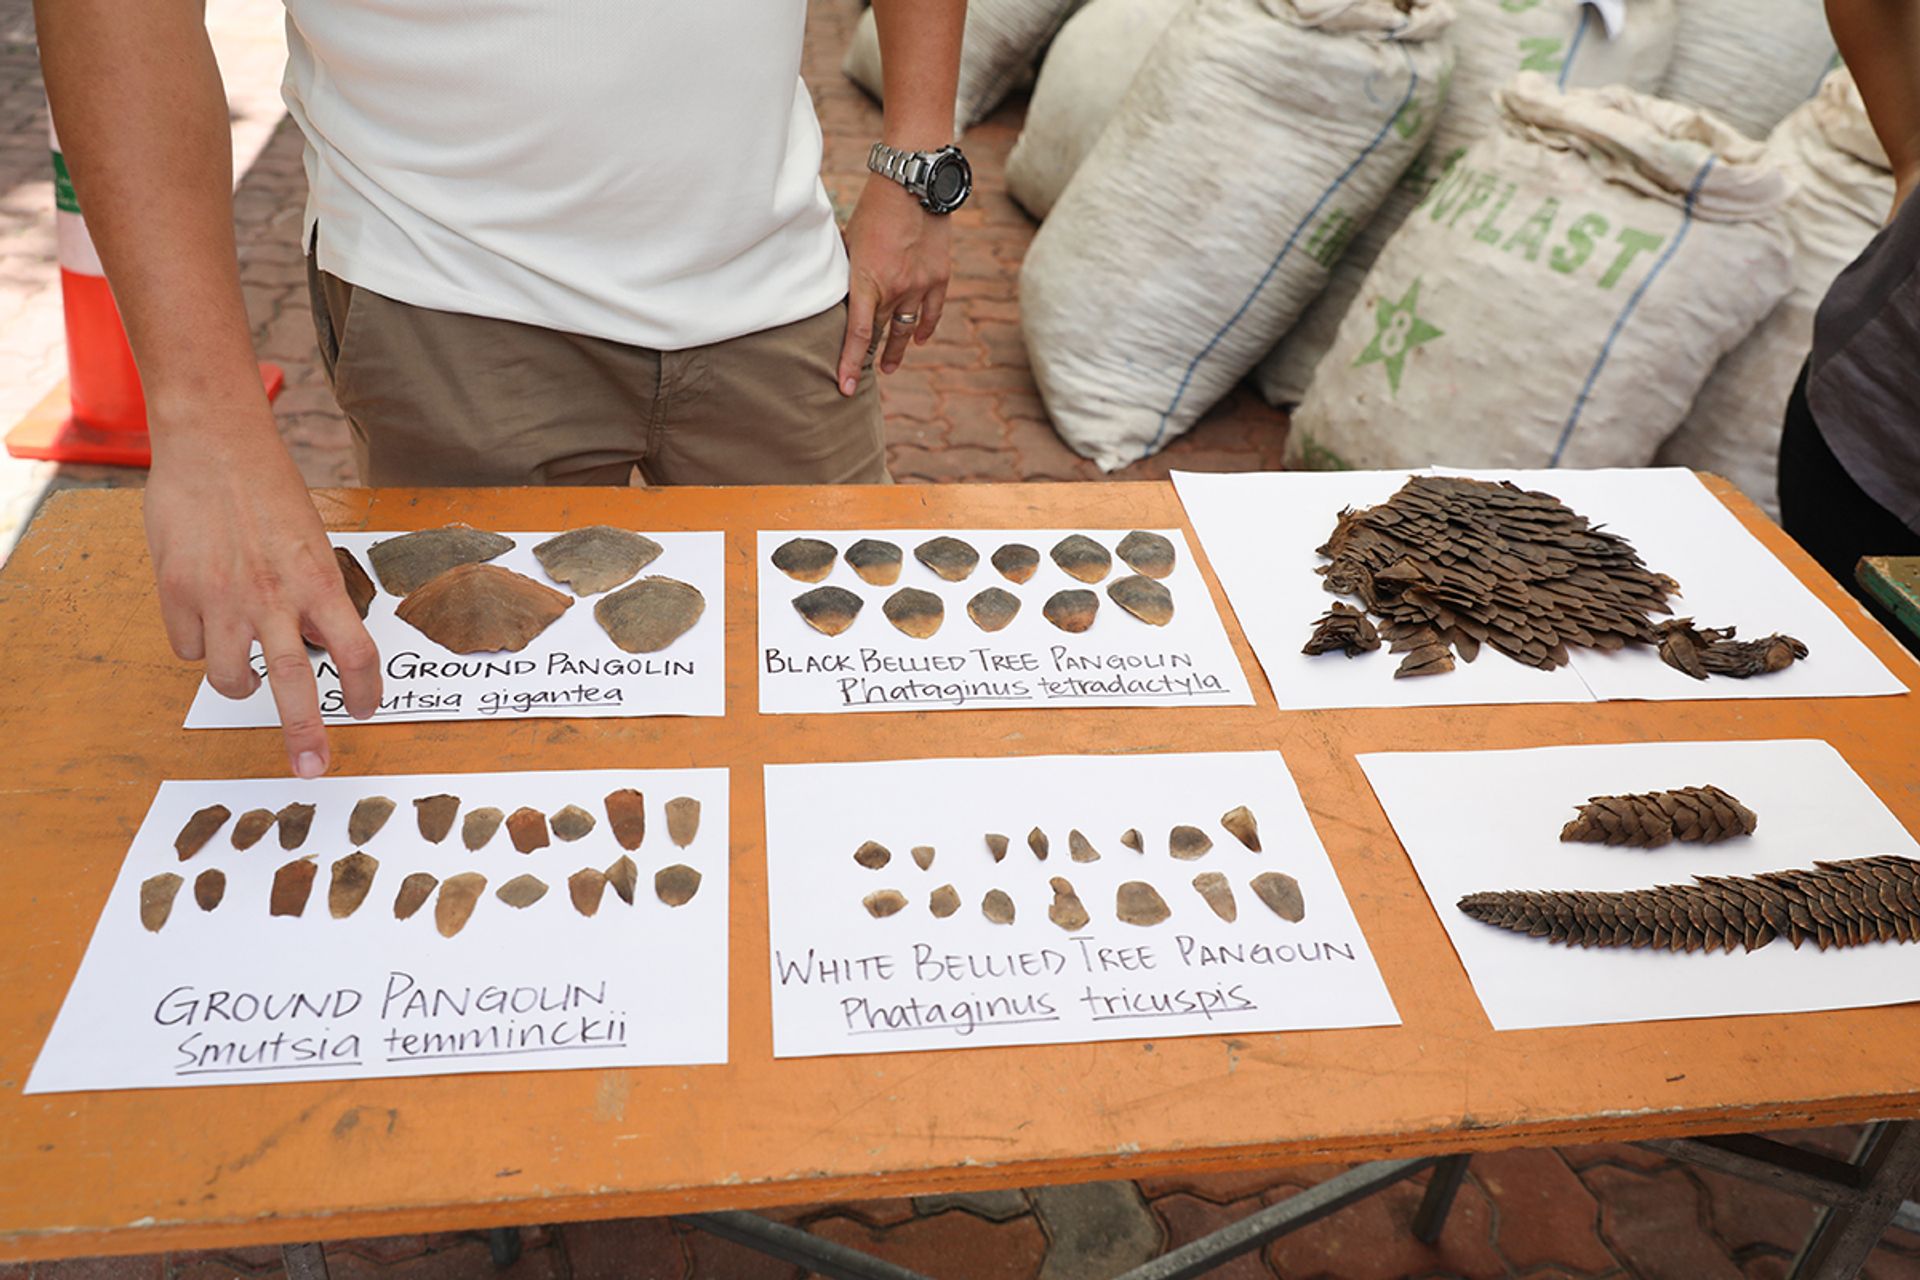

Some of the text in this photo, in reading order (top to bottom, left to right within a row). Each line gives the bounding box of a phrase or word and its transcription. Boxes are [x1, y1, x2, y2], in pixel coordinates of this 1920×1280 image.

[1380, 310, 1412, 357] 8
[387, 651, 696, 680] GROUND PANGOLIN
[765, 645, 1193, 674] BLACK BELLIED TREE PANGOLIN
[320, 685, 625, 714] Sutsia gigantea
[838, 671, 1224, 706] Phataginus tetradactyla
[776, 934, 1356, 985] WHITE BELLIED TREE PANGOLIN
[153, 971, 606, 1026] GROUND PANGOLIN
[841, 983, 1258, 1036] Phataginus tricuspis
[175, 1011, 627, 1068] Smutsia temminckii
